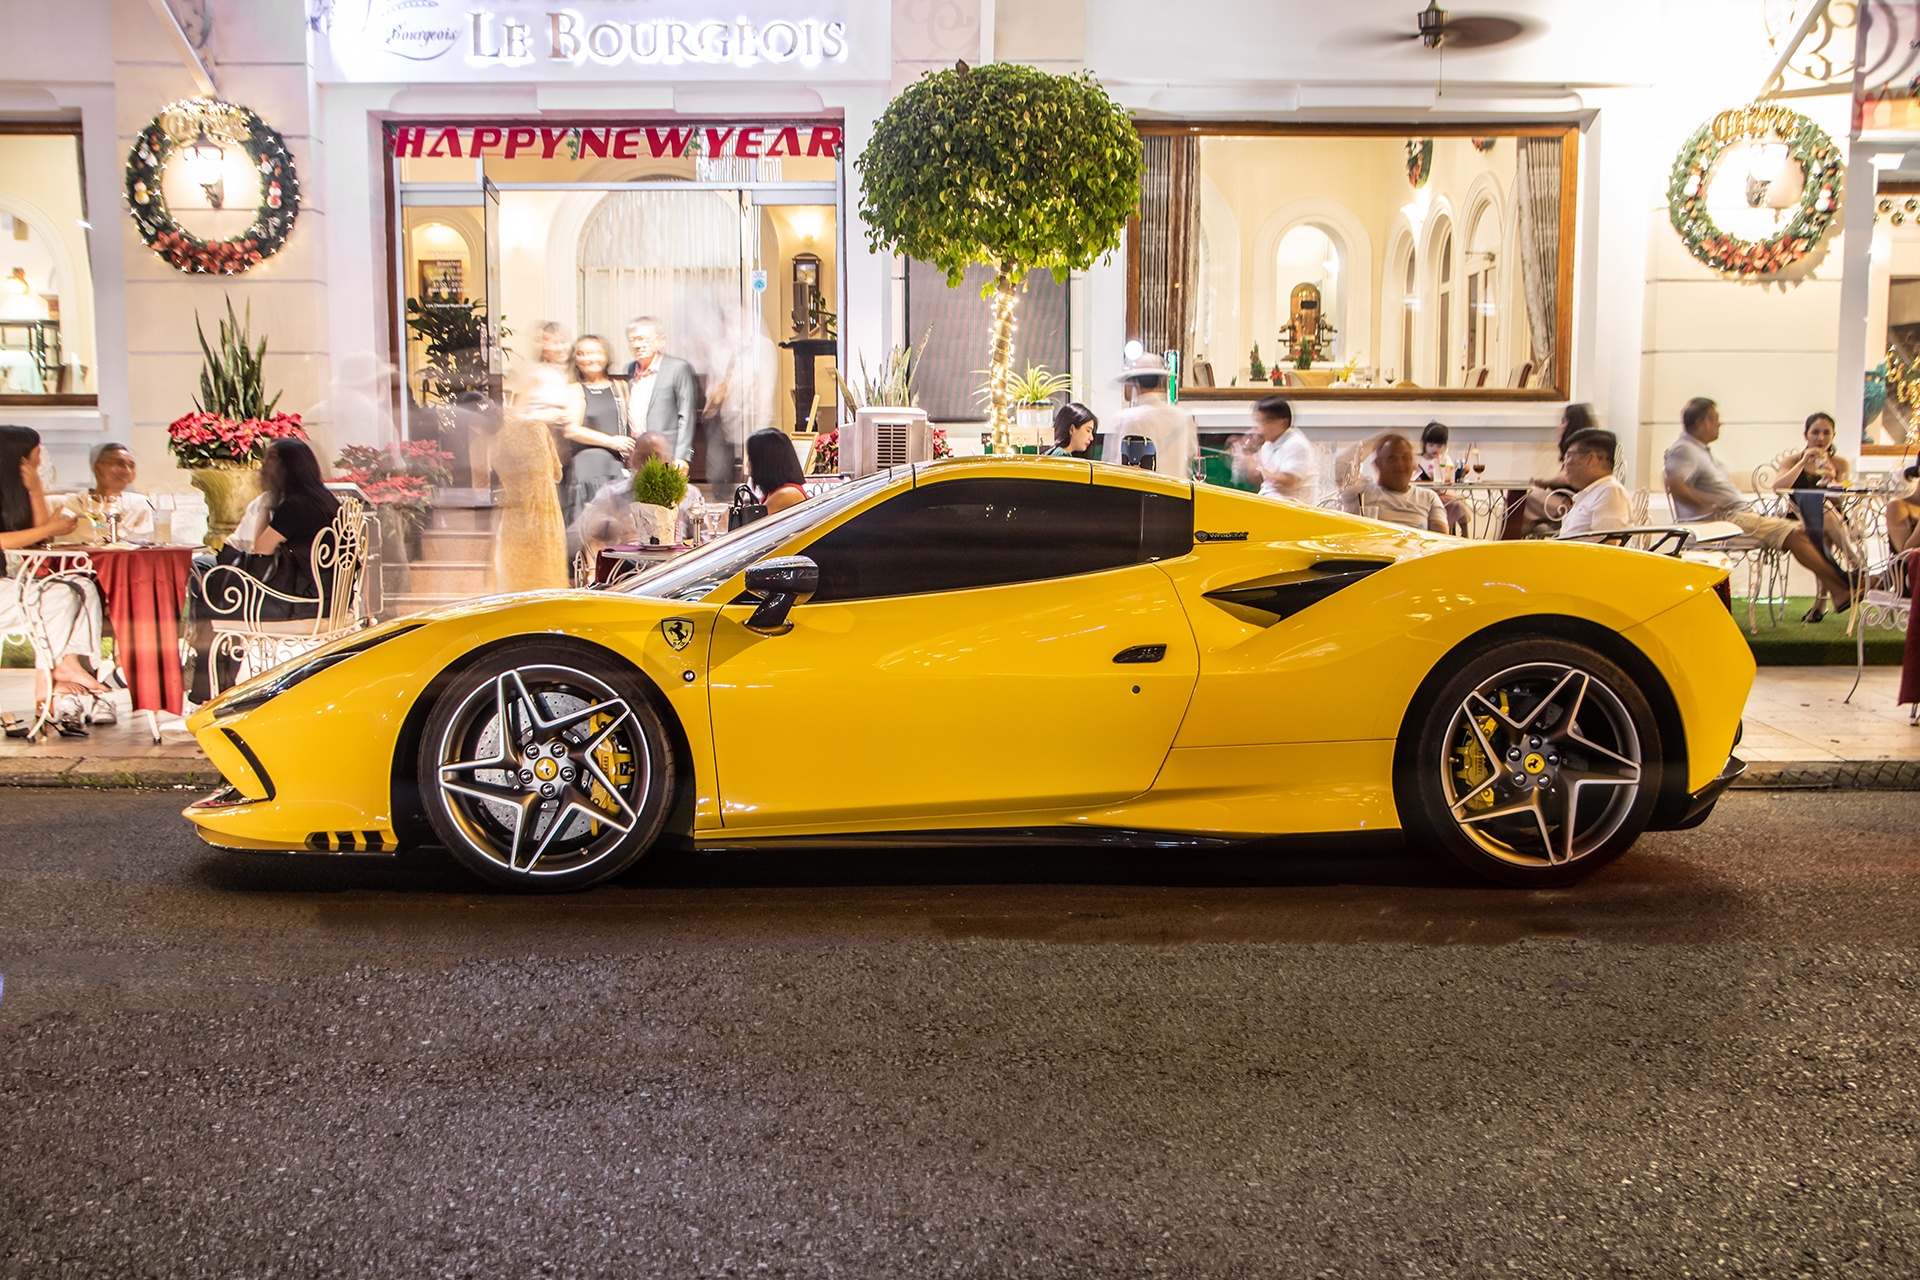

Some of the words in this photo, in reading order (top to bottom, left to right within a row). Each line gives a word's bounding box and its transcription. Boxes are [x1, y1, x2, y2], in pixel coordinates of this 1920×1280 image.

[465, 12, 528, 58] LE
[546, 12, 843, 58] BOURGEOIS
[394, 126, 570, 160] HAPPY
[579, 126, 695, 160] NEW
[705, 126, 843, 160] YEAR
